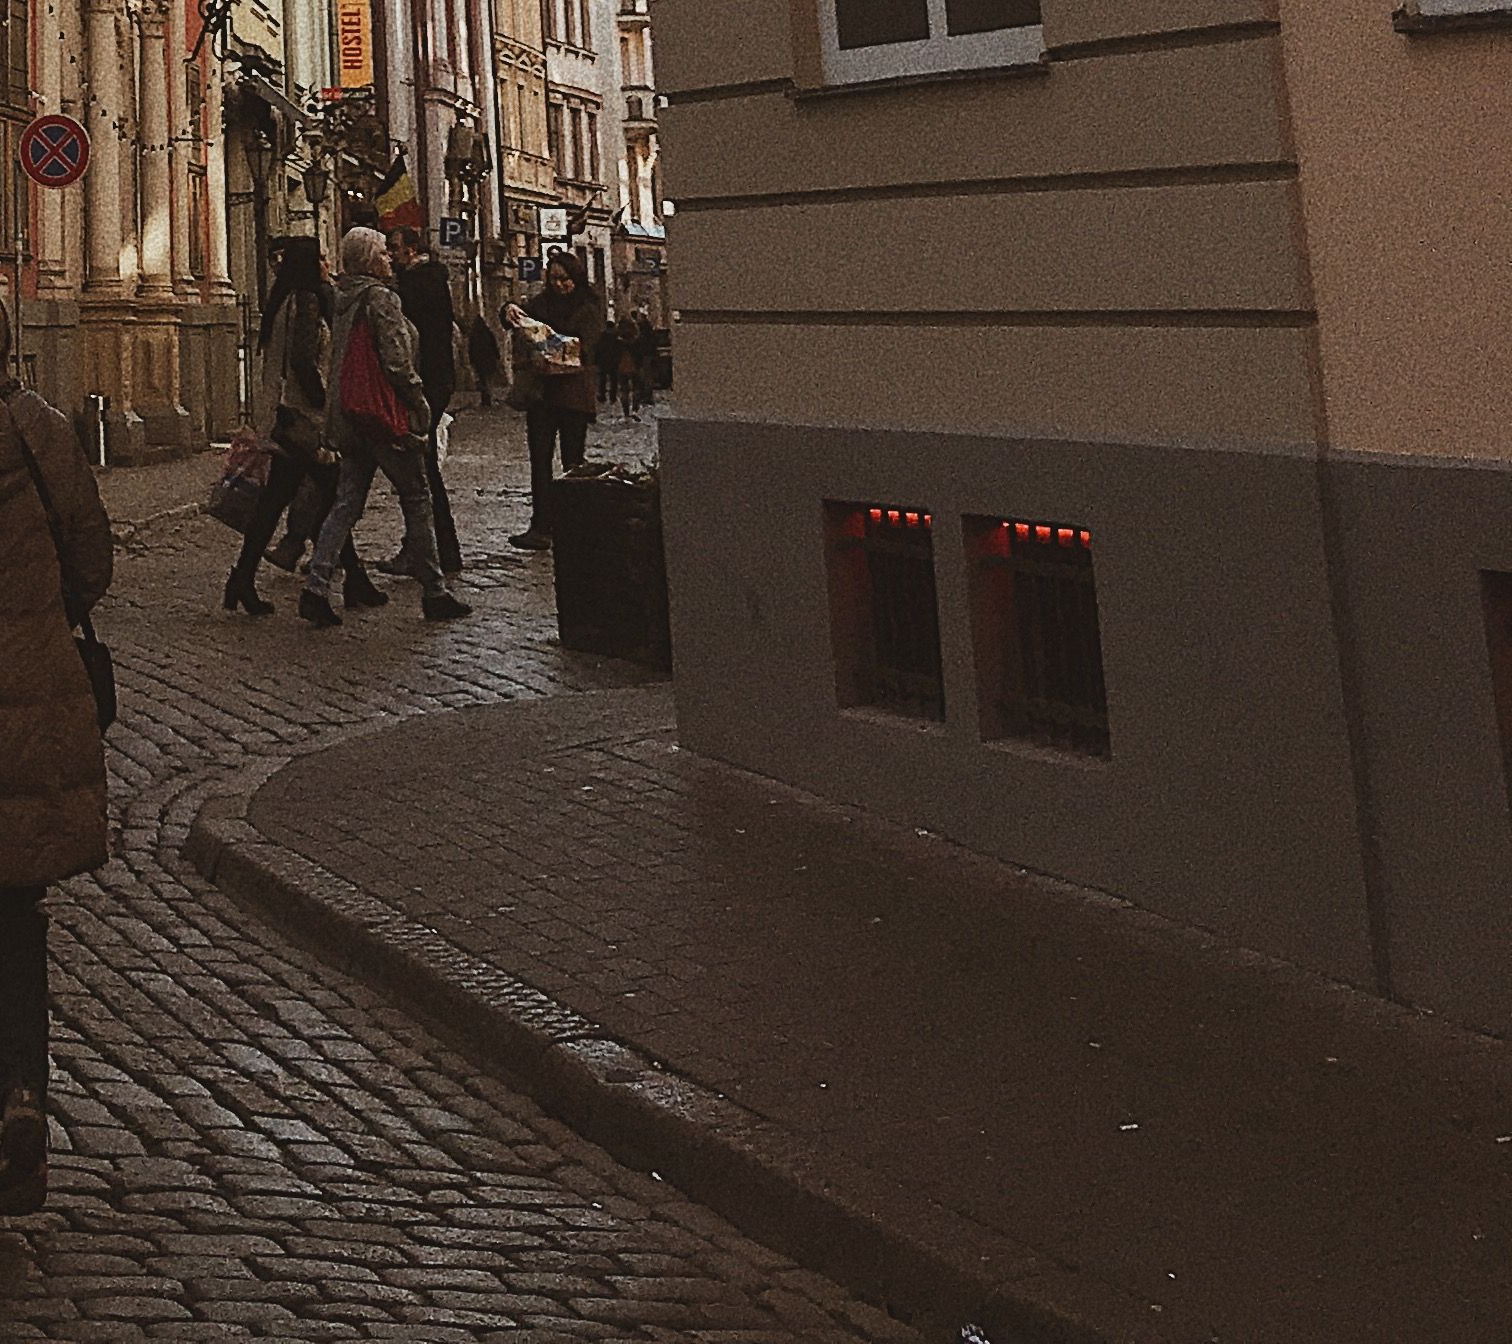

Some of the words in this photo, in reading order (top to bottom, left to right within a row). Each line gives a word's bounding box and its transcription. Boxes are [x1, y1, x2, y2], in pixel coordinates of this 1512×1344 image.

[341, 7, 363, 70] HOSTEL
[446, 221, 461, 242] P
[523, 259, 536, 278] P
